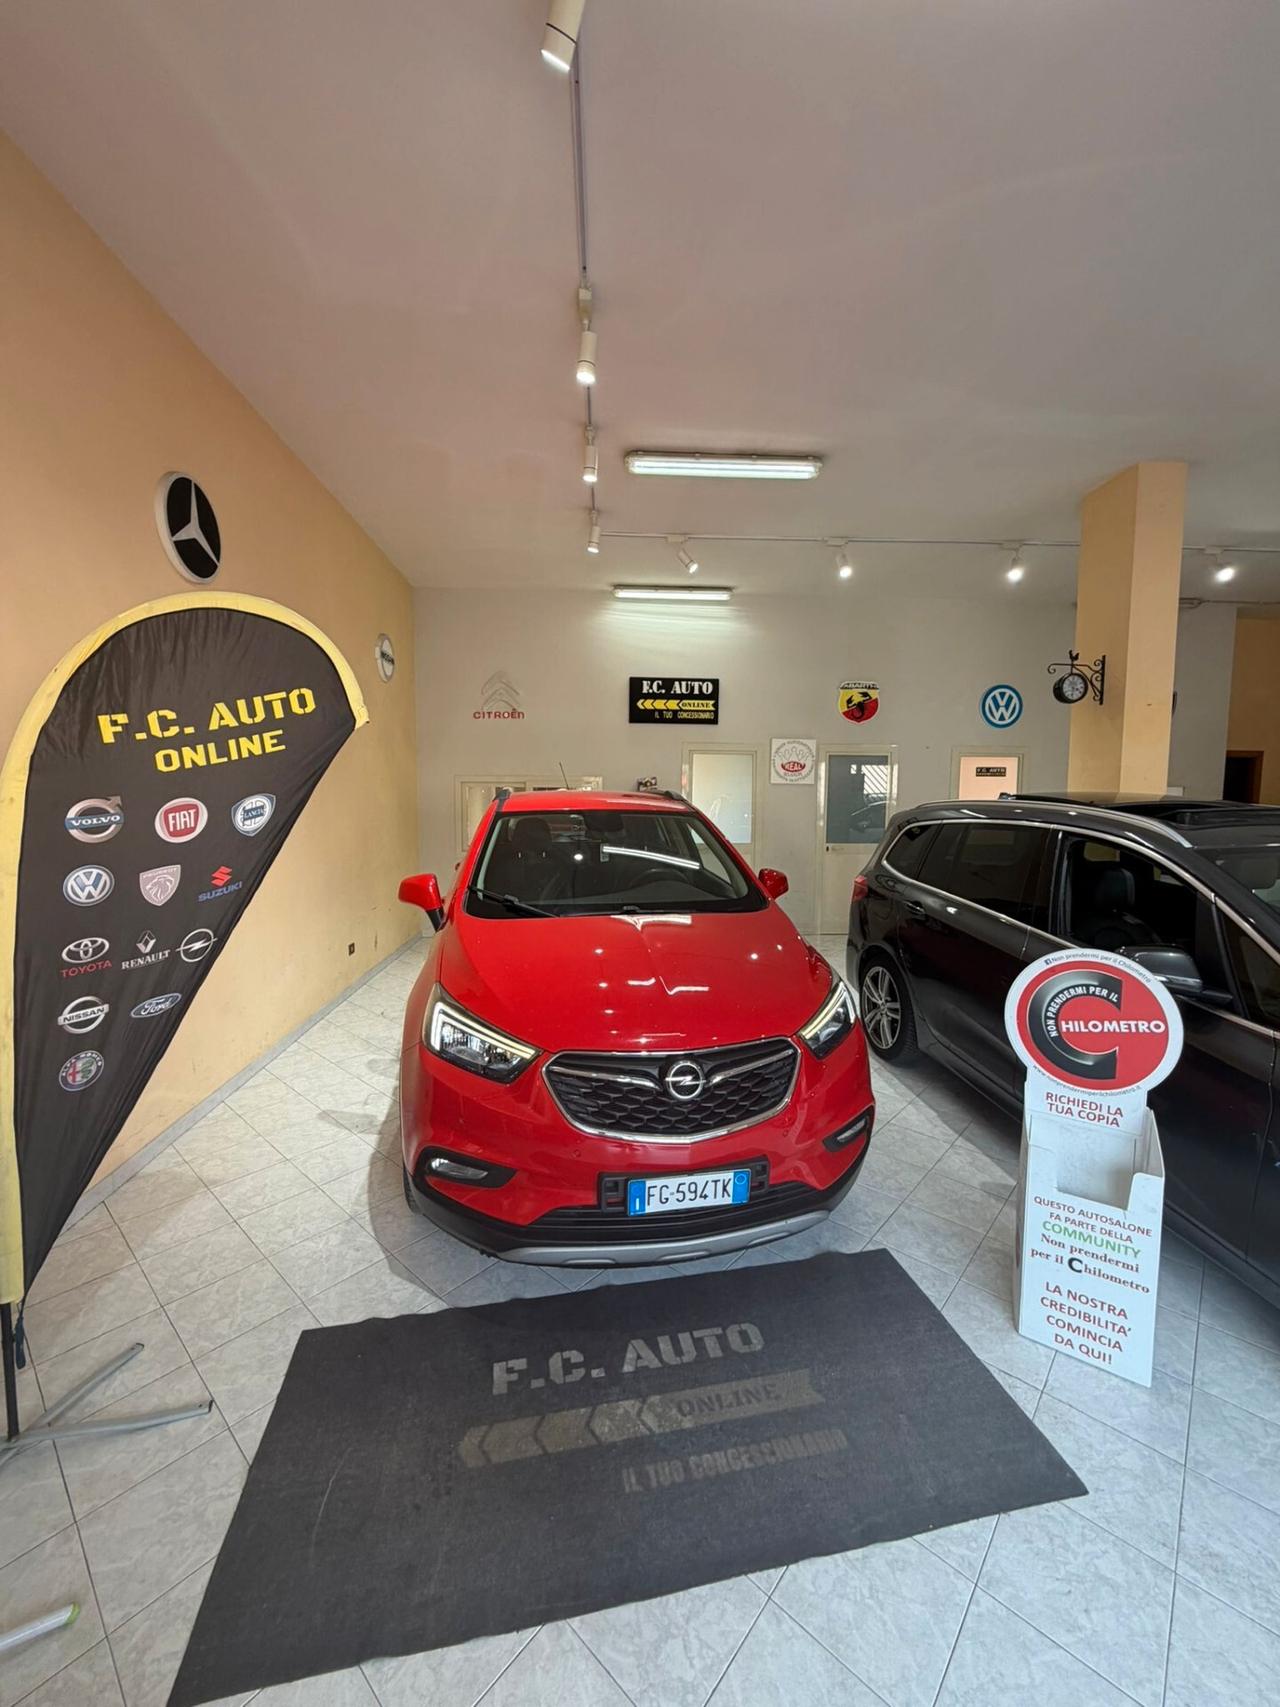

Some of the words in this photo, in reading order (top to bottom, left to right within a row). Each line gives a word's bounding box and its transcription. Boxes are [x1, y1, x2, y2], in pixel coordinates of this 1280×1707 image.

[642, 680, 666, 694] F.C.
[671, 681, 713, 695] AUTO
[97, 709, 195, 744] F.C.
[209, 687, 317, 731] AUTO
[155, 730, 286, 773] ONLINE
[71, 815, 121, 827] VOLVO
[168, 809, 197, 832] FIAT
[198, 881, 243, 902] SUZUKI
[60, 960, 112, 978] TOYOTA
[121, 950, 171, 969] RENAULT
[1065, 952, 1100, 961] prendermi
[1100, 954, 1112, 962] per
[1118, 959, 1152, 983] Chilometro
[141, 999, 171, 1015] Ford
[1047, 986, 1087, 1018] PRENDERMI
[1089, 986, 1108, 998] PER
[1109, 993, 1119, 1003] IL
[63, 1007, 105, 1022] NISSAN
[1047, 1019, 1058, 1038] NON
[1045, 1091, 1103, 1112] RICHIEDI
[1107, 1105, 1123, 1118] LA
[1047, 1102, 1073, 1117] TUA
[1078, 1111, 1120, 1128] COPIA
[1034, 1196, 1075, 1214] QUESTO
[1078, 1208, 1152, 1237] AUTOSALONE
[1050, 1212, 1062, 1221] FA
[1064, 1216, 1097, 1233] PARTE
[1100, 1226, 1133, 1244] DELLA
[1041, 1233, 1065, 1249] Non
[1069, 1243, 1140, 1273] prendermi
[1042, 1220, 1141, 1259] COMMUNITY
[1031, 1247, 1051, 1260] per
[1055, 1253, 1064, 1265] il
[1068, 1257, 1150, 1294] Chilometro
[1045, 1281, 1062, 1297] LA
[1067, 1289, 1128, 1319] NOSTRA
[1046, 1315, 1123, 1352] COMINCIA
[1054, 1333, 1074, 1349] DA
[1079, 1344, 1112, 1365] QUI!
[492, 1349, 606, 1395] F.C.
[622, 1322, 765, 1373] AUTO
[678, 1383, 781, 1418] ONLINE
[622, 1467, 644, 1493] IL
[648, 1459, 685, 1489] TUO
